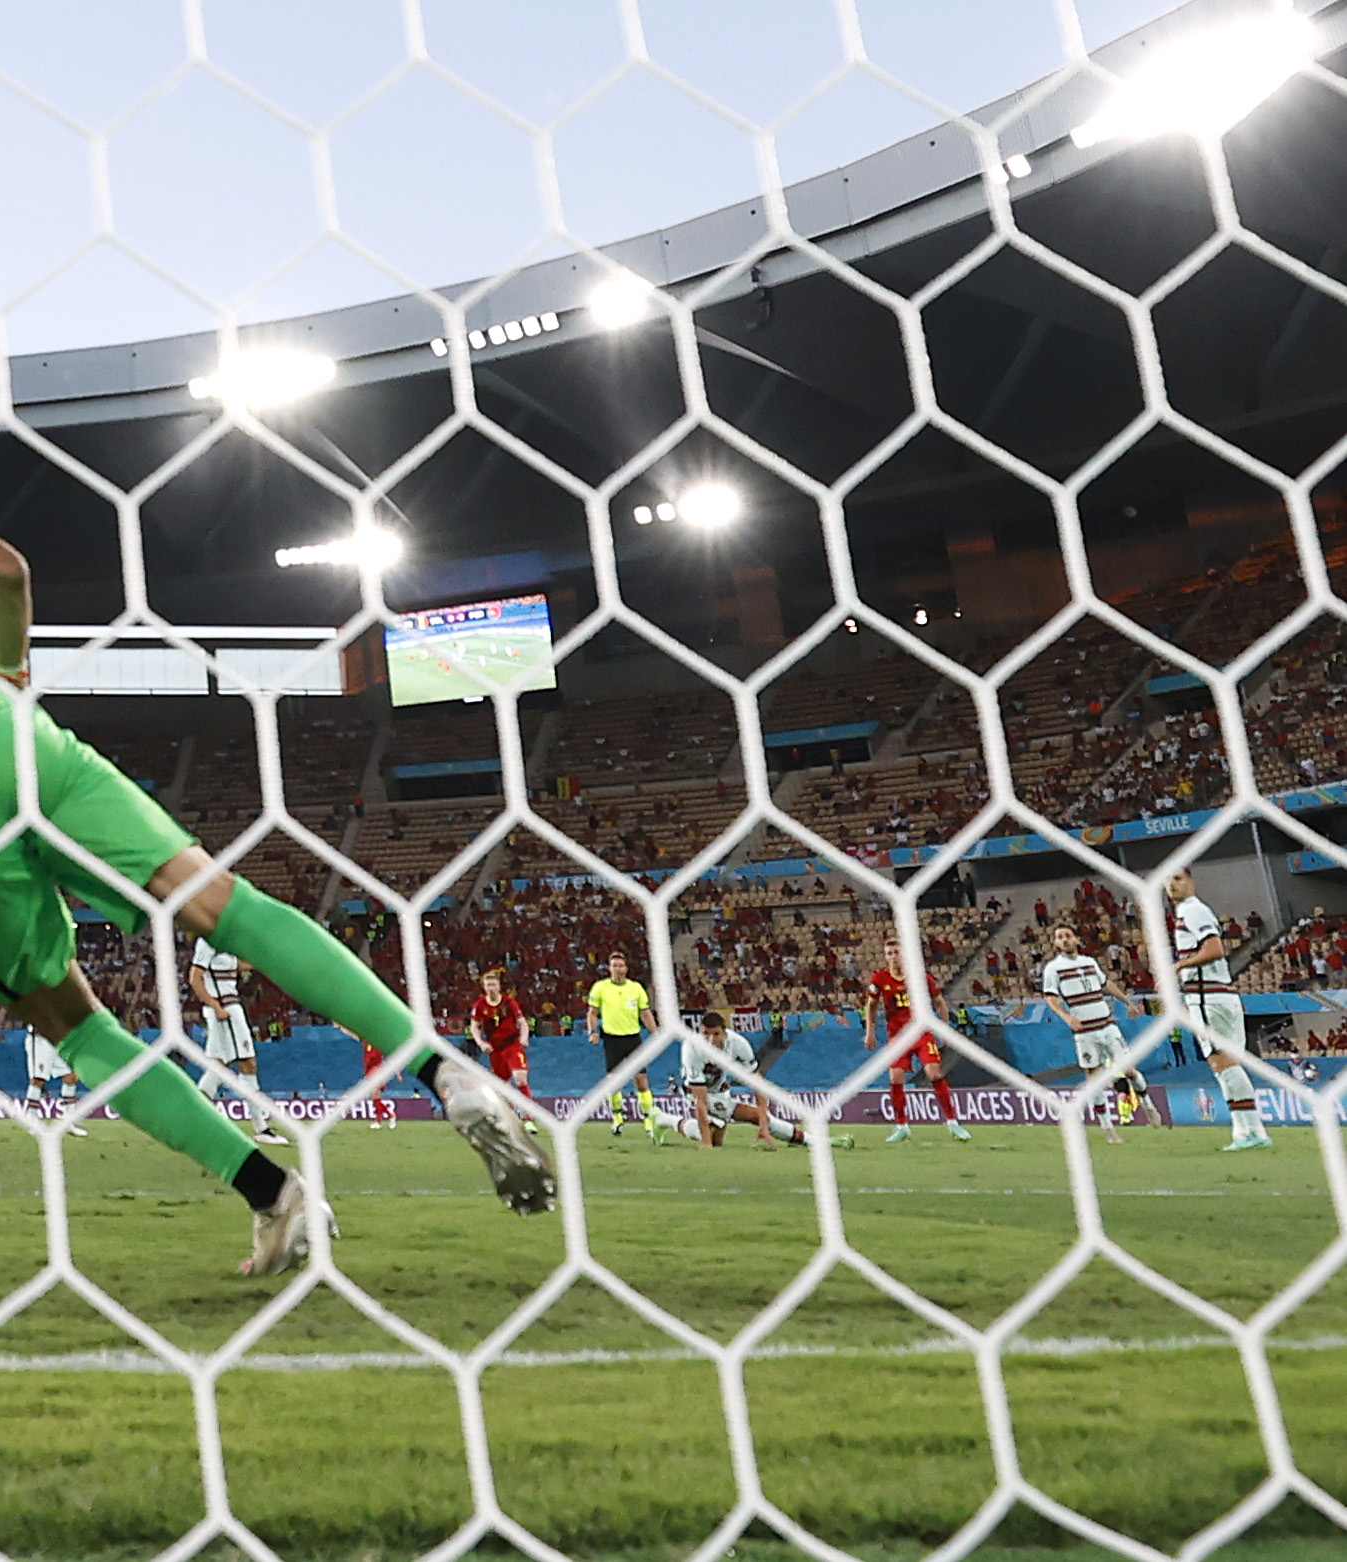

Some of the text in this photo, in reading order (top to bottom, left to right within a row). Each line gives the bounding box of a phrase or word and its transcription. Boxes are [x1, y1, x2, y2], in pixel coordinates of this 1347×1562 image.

[1145, 815, 1191, 835] SEVILLE
[880, 1091, 940, 1121] GING
[951, 1091, 1015, 1121] LACES
[1255, 1088, 1347, 1121] EVILA
